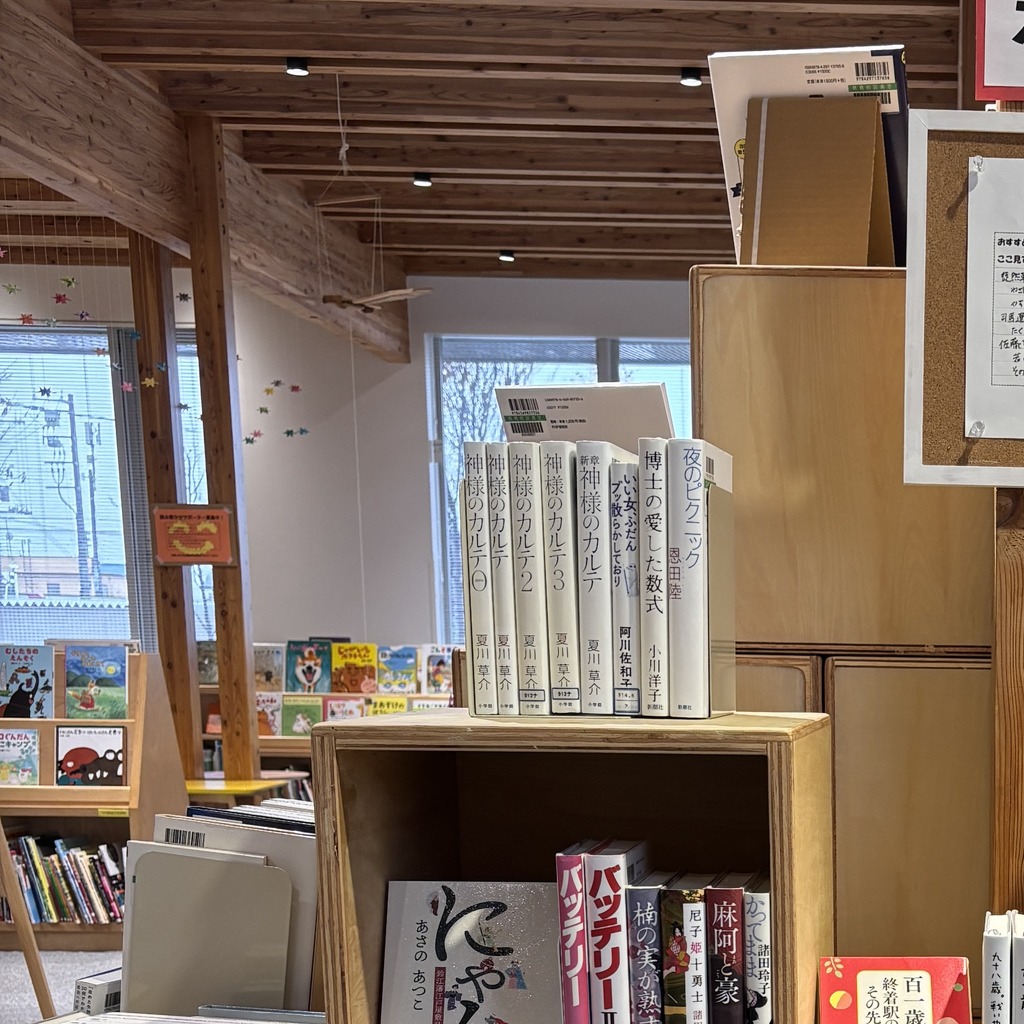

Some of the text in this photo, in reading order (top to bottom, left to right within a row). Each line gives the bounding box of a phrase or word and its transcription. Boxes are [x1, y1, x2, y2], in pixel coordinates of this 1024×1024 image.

[487, 453, 509, 570] 神様のカルテ
[580, 455, 600, 466] 新章
[622, 473, 637, 552] いい女、ふだん
[683, 446, 705, 570] 夜のピクニック
[513, 453, 537, 593] 神様のカルテ2
[544, 452, 566, 592] 神様のカルテ3
[580, 467, 603, 593] 神様のカルテ
[610, 481, 622, 588] ブッ散らかしており
[644, 451, 663, 615] 博士の愛した数式
[669, 547, 682, 600] 恩田陸
[619, 626, 632, 687] 阿川佐和子
[648, 644, 662, 703] 小川洋子
[559, 865, 585, 1007] バッテリー
[688, 908, 704, 1004] 尼子姫十勇士
[712, 901, 739, 1006] 麻阿と豪
[757, 943, 771, 996] 諸田玲子
